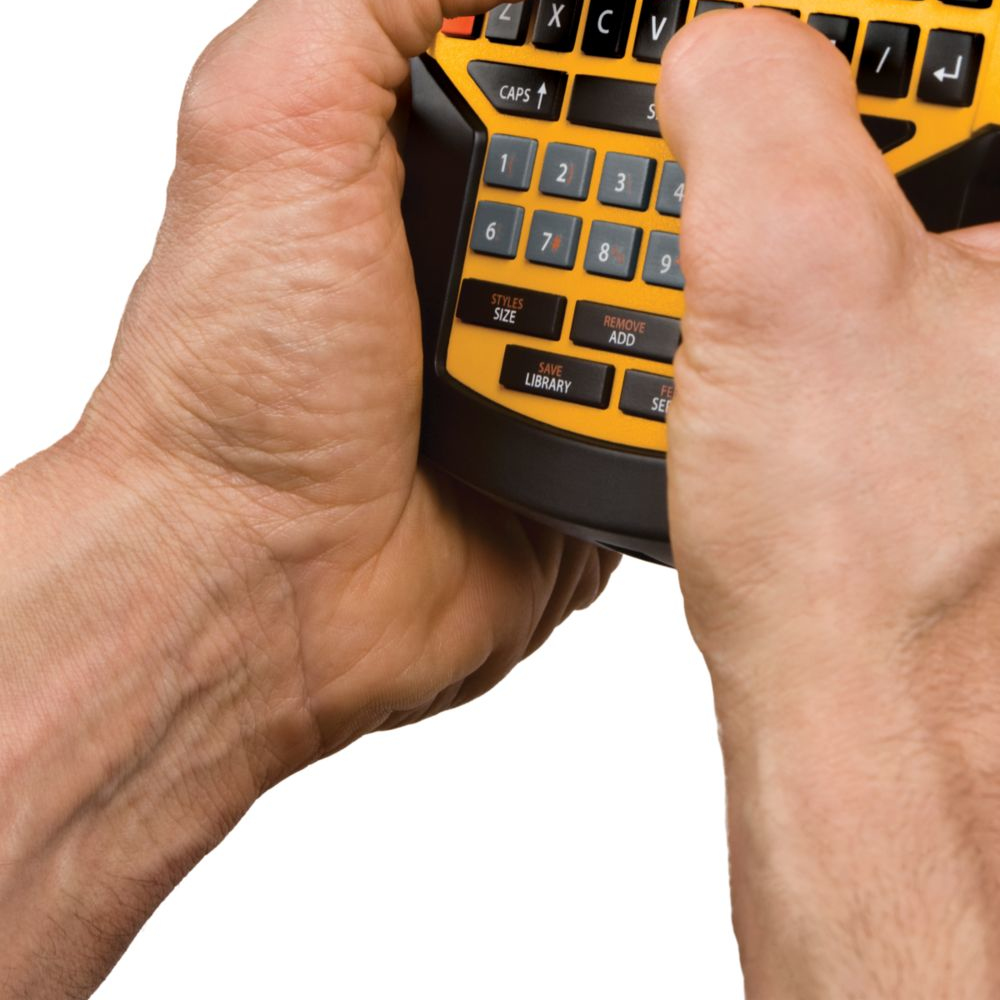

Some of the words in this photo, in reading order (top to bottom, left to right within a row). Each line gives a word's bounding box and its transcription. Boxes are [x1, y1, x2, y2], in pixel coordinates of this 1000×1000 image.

[547, 3, 566, 28] X
[597, 9, 614, 34] C
[651, 15, 667, 41] V
[499, 85, 531, 103] CAPS
[614, 172, 626, 193] 3
[673, 183, 684, 202] 4
[485, 221, 497, 241] 6
[660, 254, 672, 274] 9
[491, 293, 524, 310] STYLES
[493, 307, 517, 324] SIZE
[603, 315, 646, 334] REMOVE
[608, 331, 636, 347] ADD
[538, 362, 563, 377] SAVE
[525, 372, 572, 394] LIBRARY
[660, 384, 673, 398] FE
